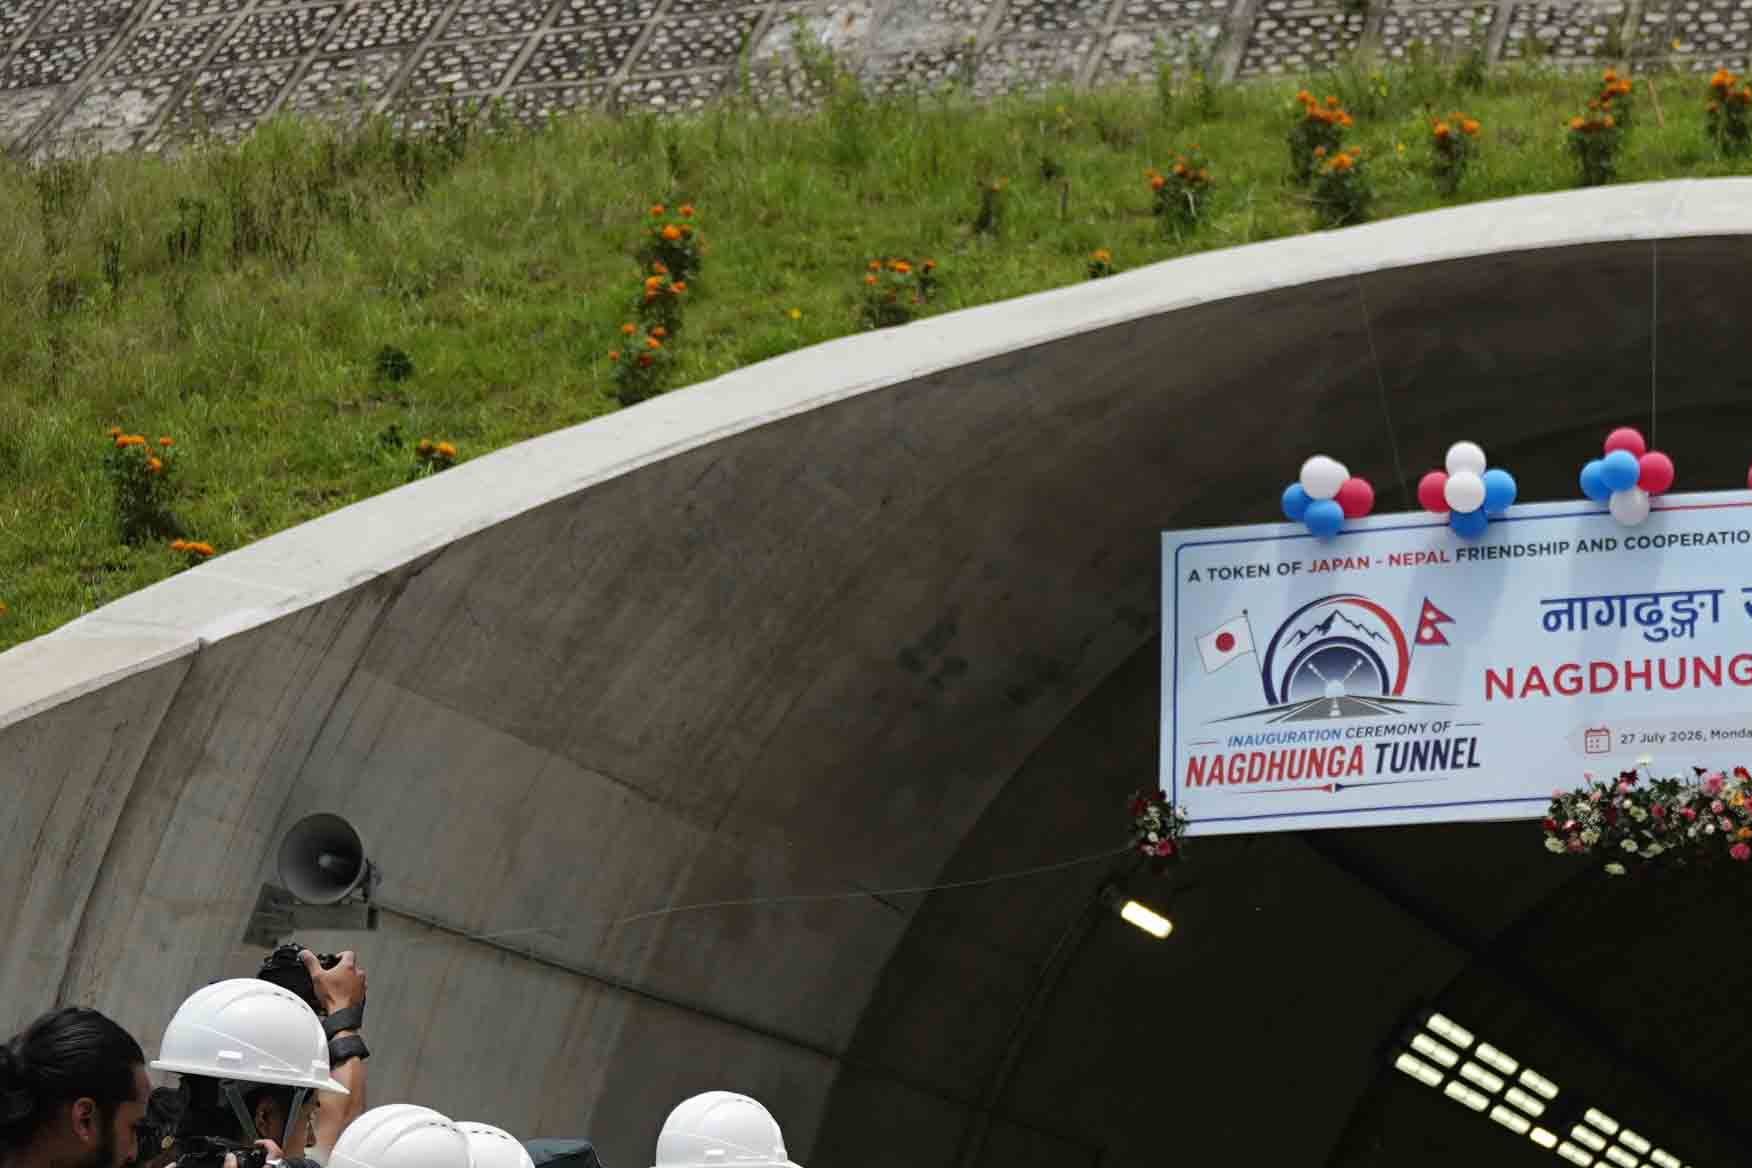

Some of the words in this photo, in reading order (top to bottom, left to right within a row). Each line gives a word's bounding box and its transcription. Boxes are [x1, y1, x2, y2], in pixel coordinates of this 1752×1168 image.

[1188, 568, 1201, 583] A
[1207, 563, 1270, 582] TOKEN
[1277, 561, 1302, 577] OF
[1308, 555, 1370, 574] JAPAN
[1388, 550, 1450, 567] NEPAL
[1456, 541, 1570, 562] FRIENDSHIP
[1576, 537, 1617, 554] AND
[1540, 589, 1725, 643] नागढुङ्गा
[1226, 728, 1343, 748] INAUGURATION
[1345, 721, 1429, 739] CEREMONY
[1431, 720, 1452, 733] OF
[1620, 734, 1636, 745] 27
[1640, 731, 1666, 744] July
[1185, 744, 1365, 789] NAGDHUNGA
[1375, 737, 1482, 776] TUNNEL
